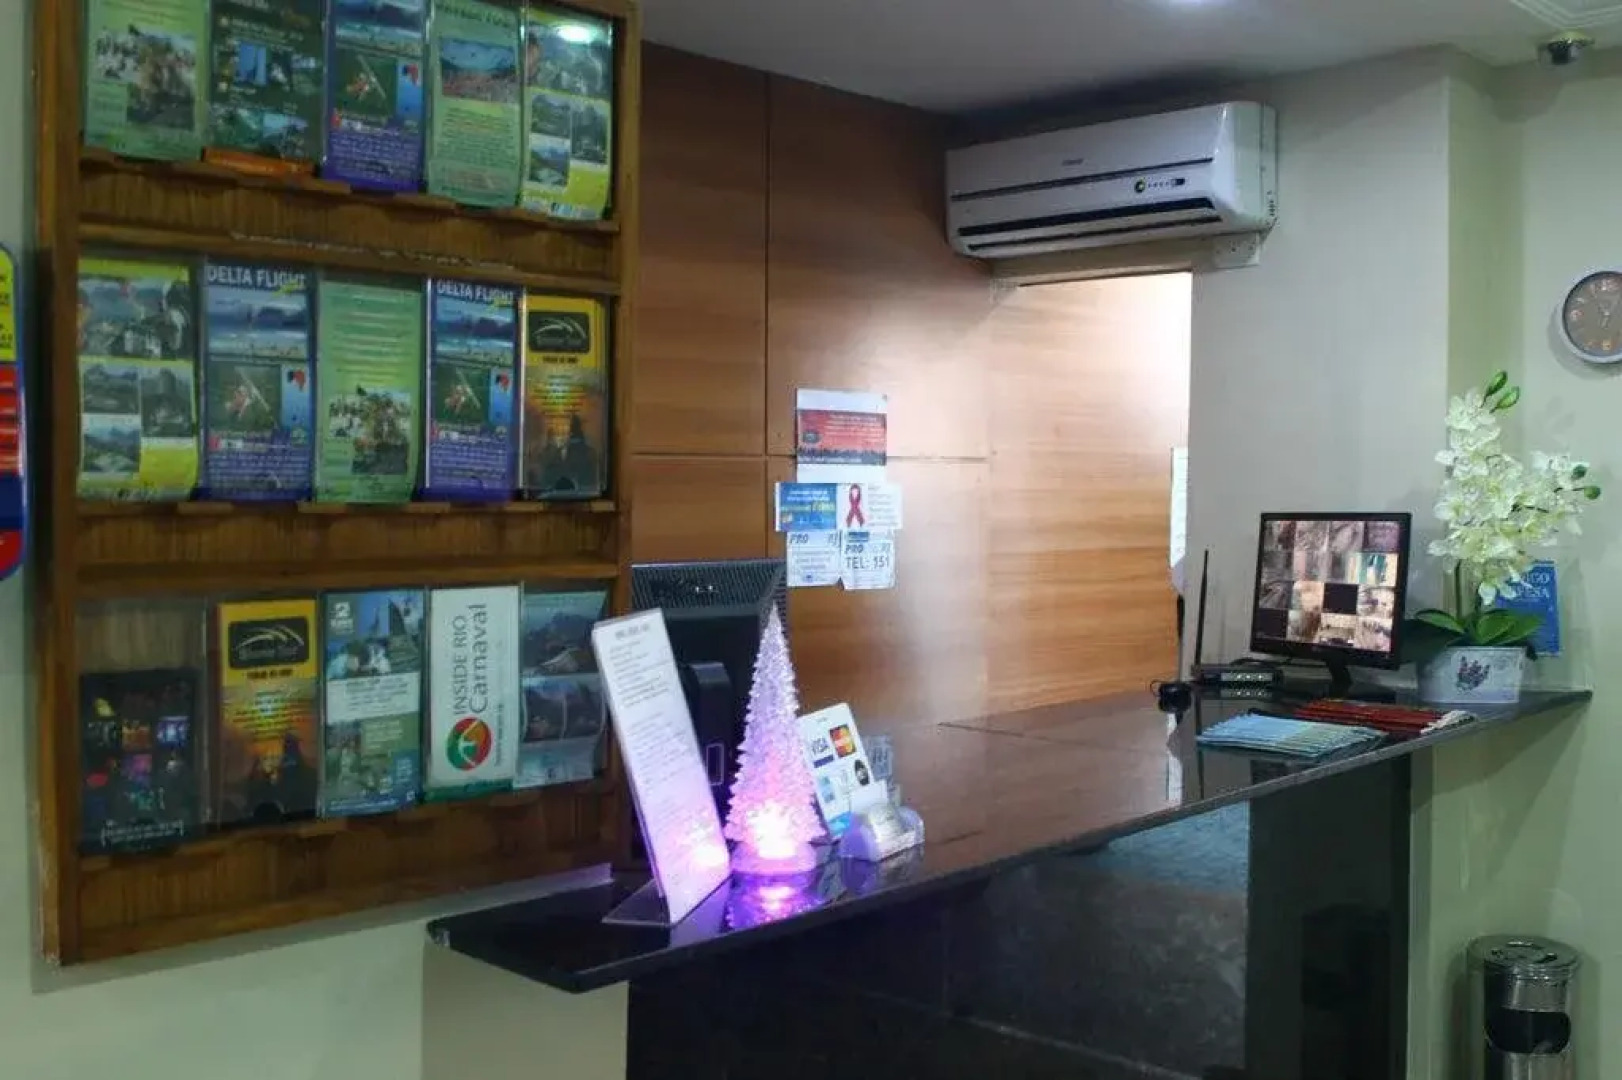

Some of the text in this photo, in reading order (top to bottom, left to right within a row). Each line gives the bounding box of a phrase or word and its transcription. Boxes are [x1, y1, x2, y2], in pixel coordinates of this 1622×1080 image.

[207, 265, 252, 286] DELTA
[436, 280, 473, 299] DELTA
[453, 615, 468, 716] INSIDE RIO
[468, 604, 488, 714] Carnaval
